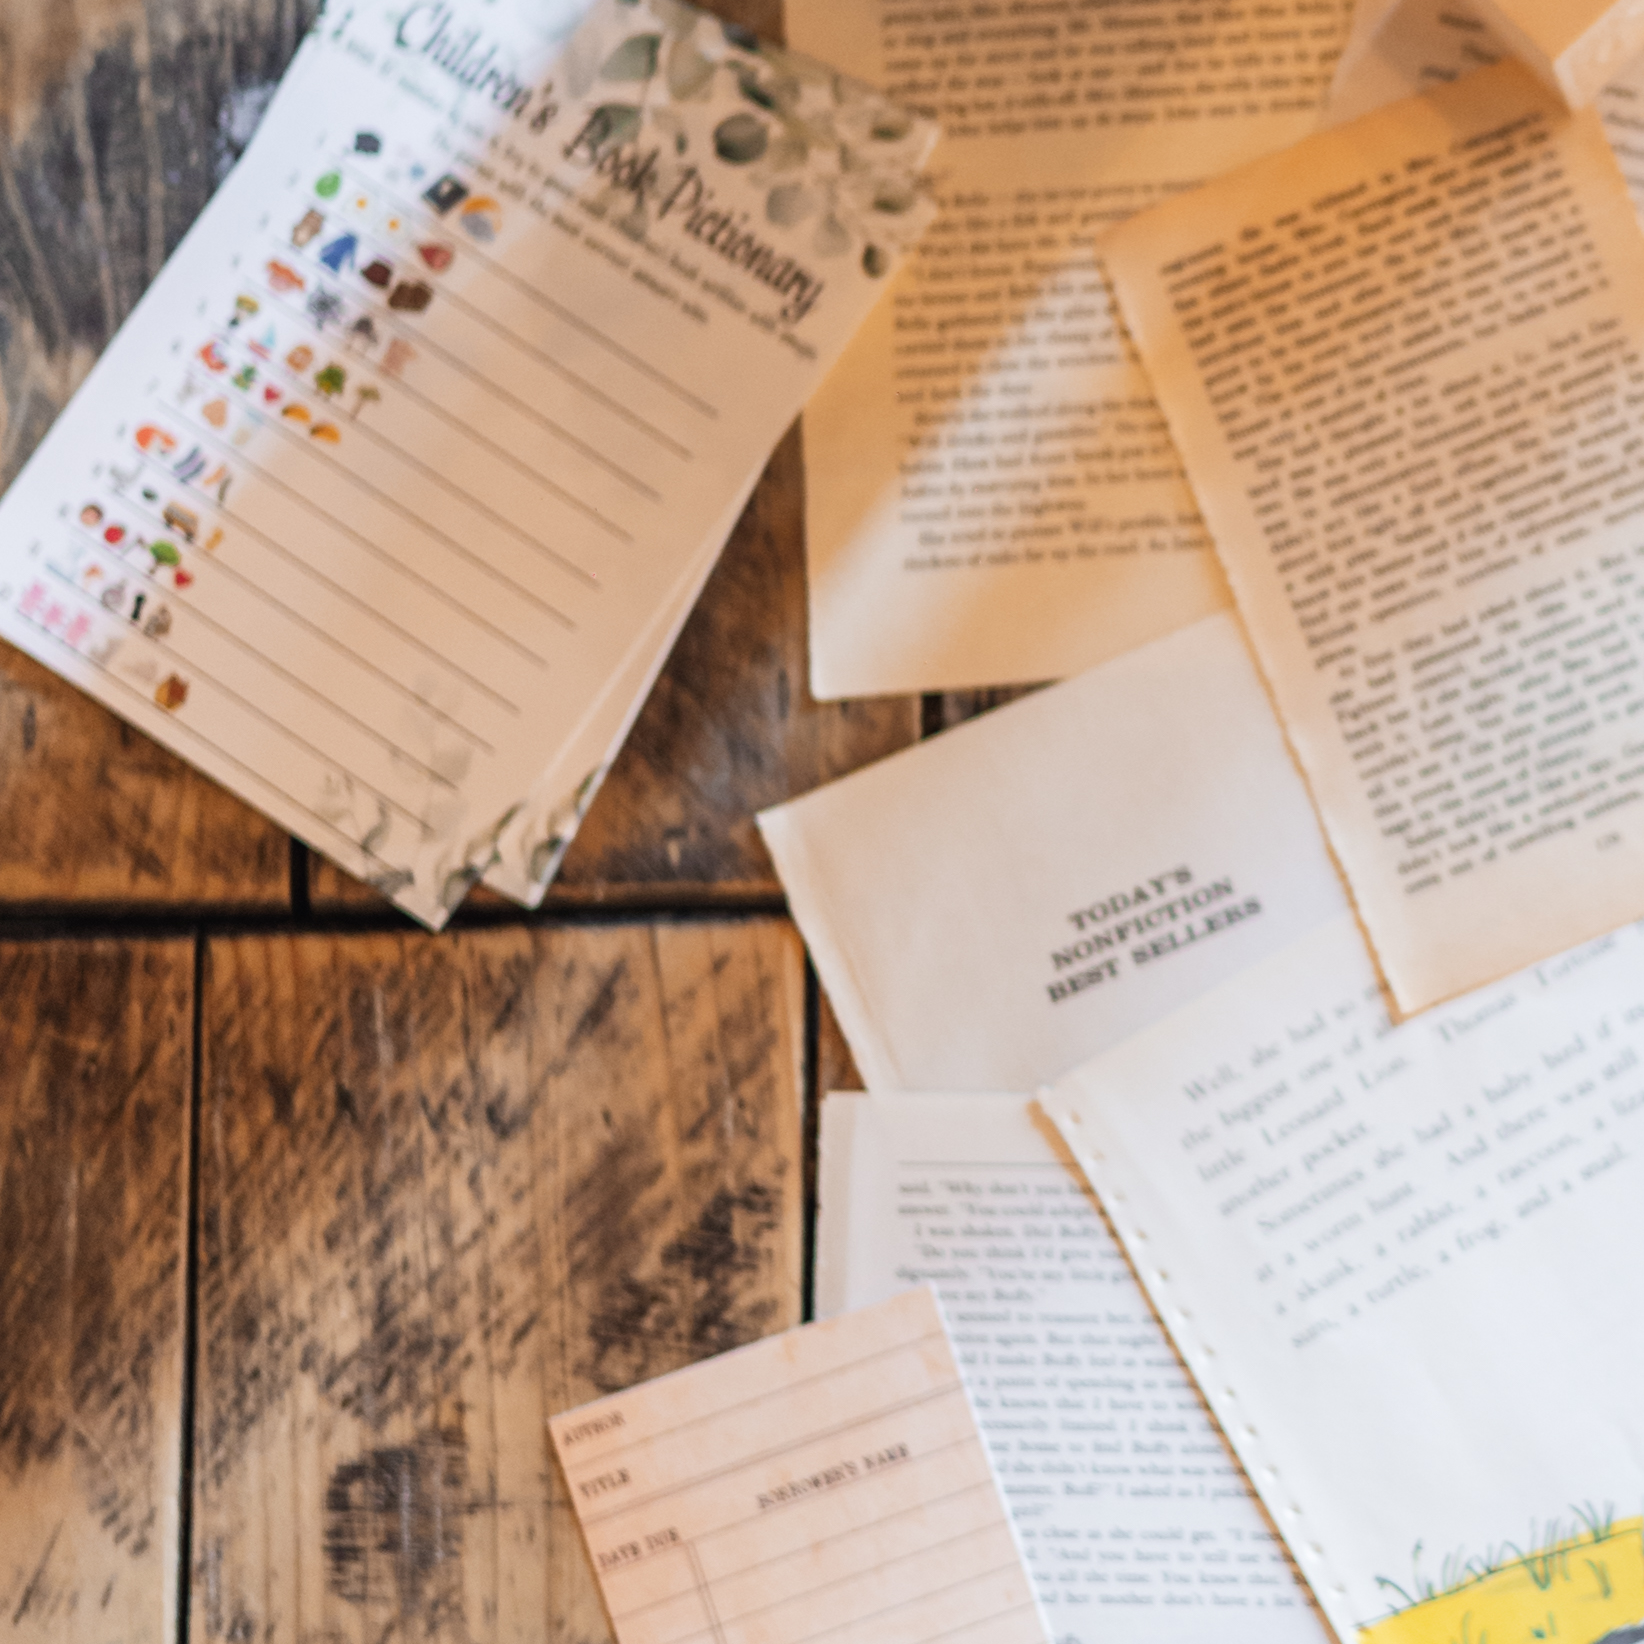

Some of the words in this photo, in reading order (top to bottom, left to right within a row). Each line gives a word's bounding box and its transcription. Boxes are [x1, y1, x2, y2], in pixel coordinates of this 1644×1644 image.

[396, 1, 555, 134] Children's
[561, 105, 659, 202] Book
[657, 163, 828, 321] Pictionary
[1049, 876, 1235, 972] NONFICTION
[1066, 864, 1193, 932] TODAY'S
[1044, 957, 1119, 1005] BEST
[1129, 896, 1262, 966] SELLERS
[1178, 1123, 1214, 1152] the
[1216, 1078, 1291, 1129] biggest
[1298, 1054, 1334, 1083] one
[1341, 1032, 1364, 1057] of
[1180, 1062, 1243, 1104] Well,
[1248, 1041, 1282, 1070] she
[1285, 1009, 1328, 1044] had
[1331, 1000, 1356, 1021] so
[1195, 1147, 1247, 1183] little
[1258, 1085, 1347, 1148] Leonard
[1355, 1054, 1411, 1092] Lion.
[1429, 991, 1518, 1046] Thomas
[1217, 1164, 1292, 1219] another
[1300, 1120, 1371, 1174] pocket.
[1255, 1166, 1367, 1236] Sometimes
[1371, 1142, 1407, 1171] she
[1411, 1109, 1455, 1146] had
[1462, 1102, 1478, 1121] a
[1480, 1070, 1534, 1105] baby
[1538, 1031, 1589, 1072] bird
[1595, 1015, 1613, 1041] if
[561, 1409, 626, 1448] AUTHOR
[755, 1460, 858, 1510] BORROWER'S
[861, 1442, 910, 1471] NAME
[596, 1539, 643, 1569] DATE
[643, 1525, 682, 1551] DUE
